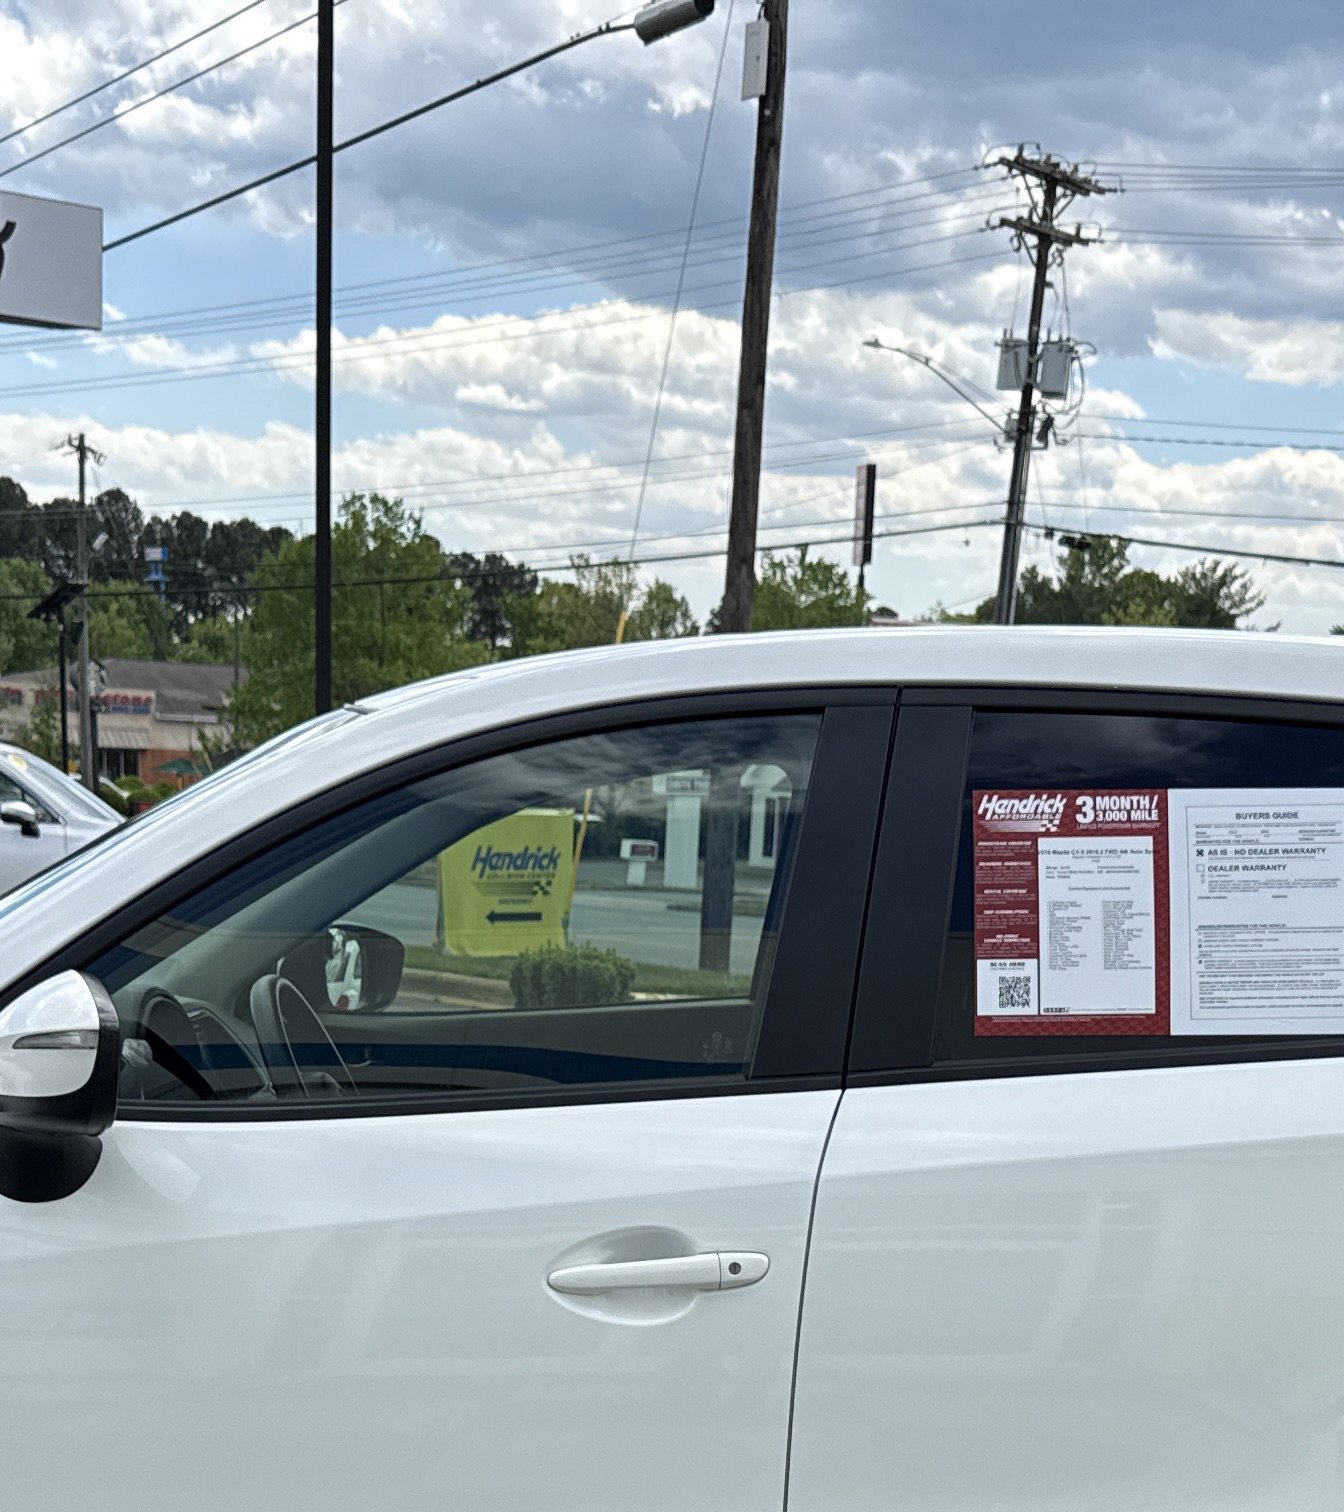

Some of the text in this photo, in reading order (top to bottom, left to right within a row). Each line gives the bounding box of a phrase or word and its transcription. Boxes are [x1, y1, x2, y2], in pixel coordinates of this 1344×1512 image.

[977, 793, 1068, 821] Hendrick
[1075, 795, 1096, 824] 3
[1096, 810, 1128, 823] 3,000
[1130, 809, 1159, 821] MILE
[1235, 811, 1299, 820] BUYERS GUIDE
[1247, 848, 1280, 856] DEALER
[1281, 847, 1327, 855] WARRANTY
[471, 846, 561, 880] Hendrick
[1207, 864, 1287, 873] DEALER WARRANTY
